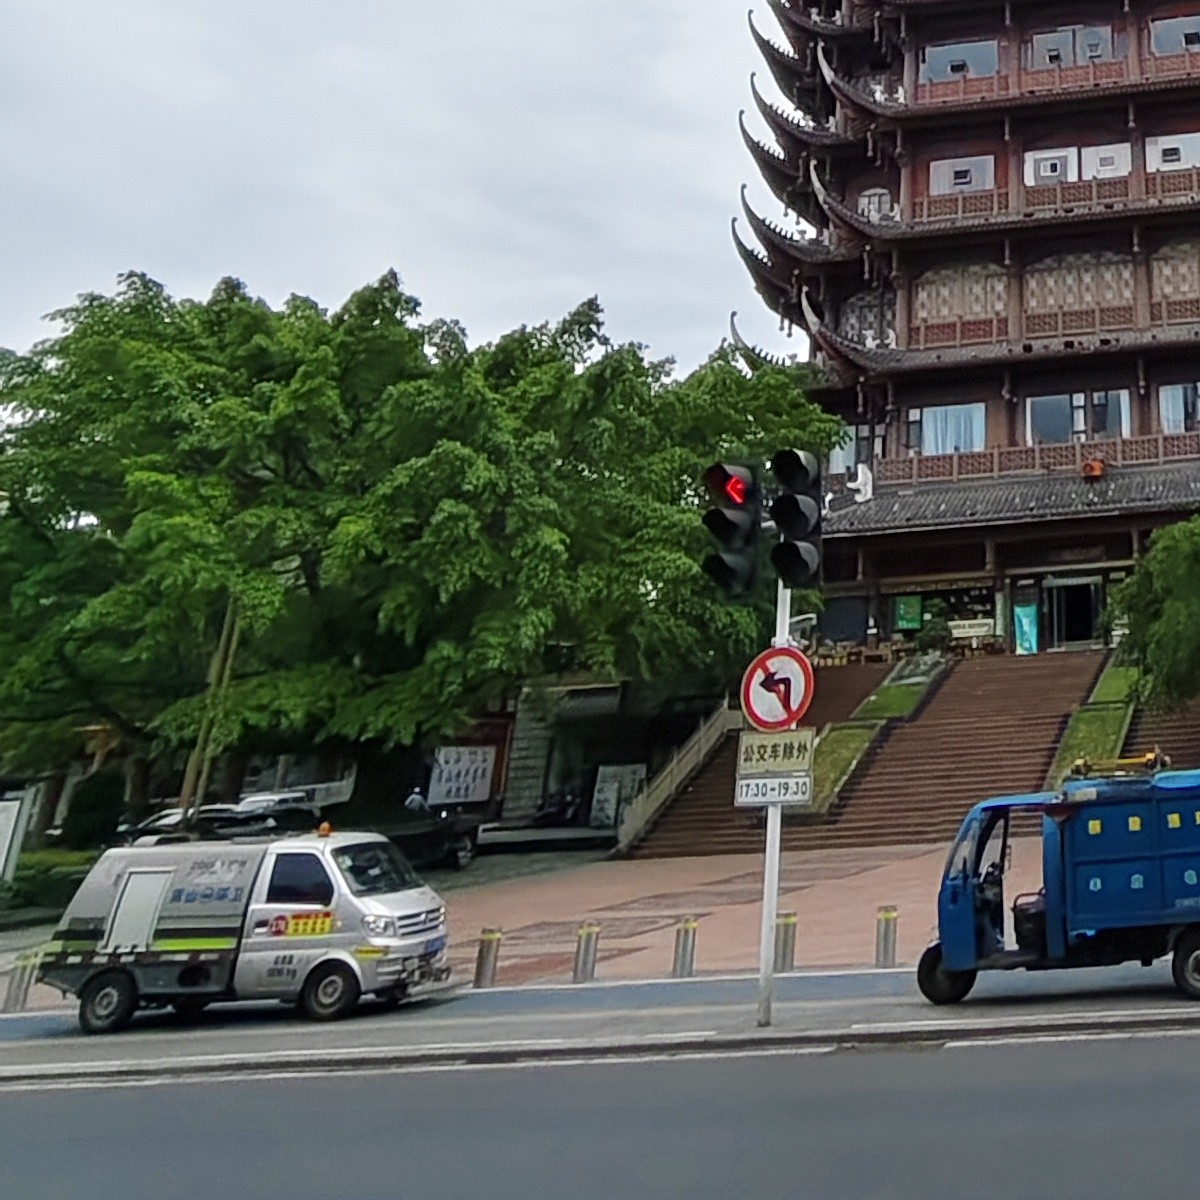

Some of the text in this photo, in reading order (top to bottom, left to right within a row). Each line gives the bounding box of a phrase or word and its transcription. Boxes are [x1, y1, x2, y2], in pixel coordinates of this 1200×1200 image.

[743, 741, 808, 763] 公交车除外
[740, 781, 808, 798] 17:30-19:30
